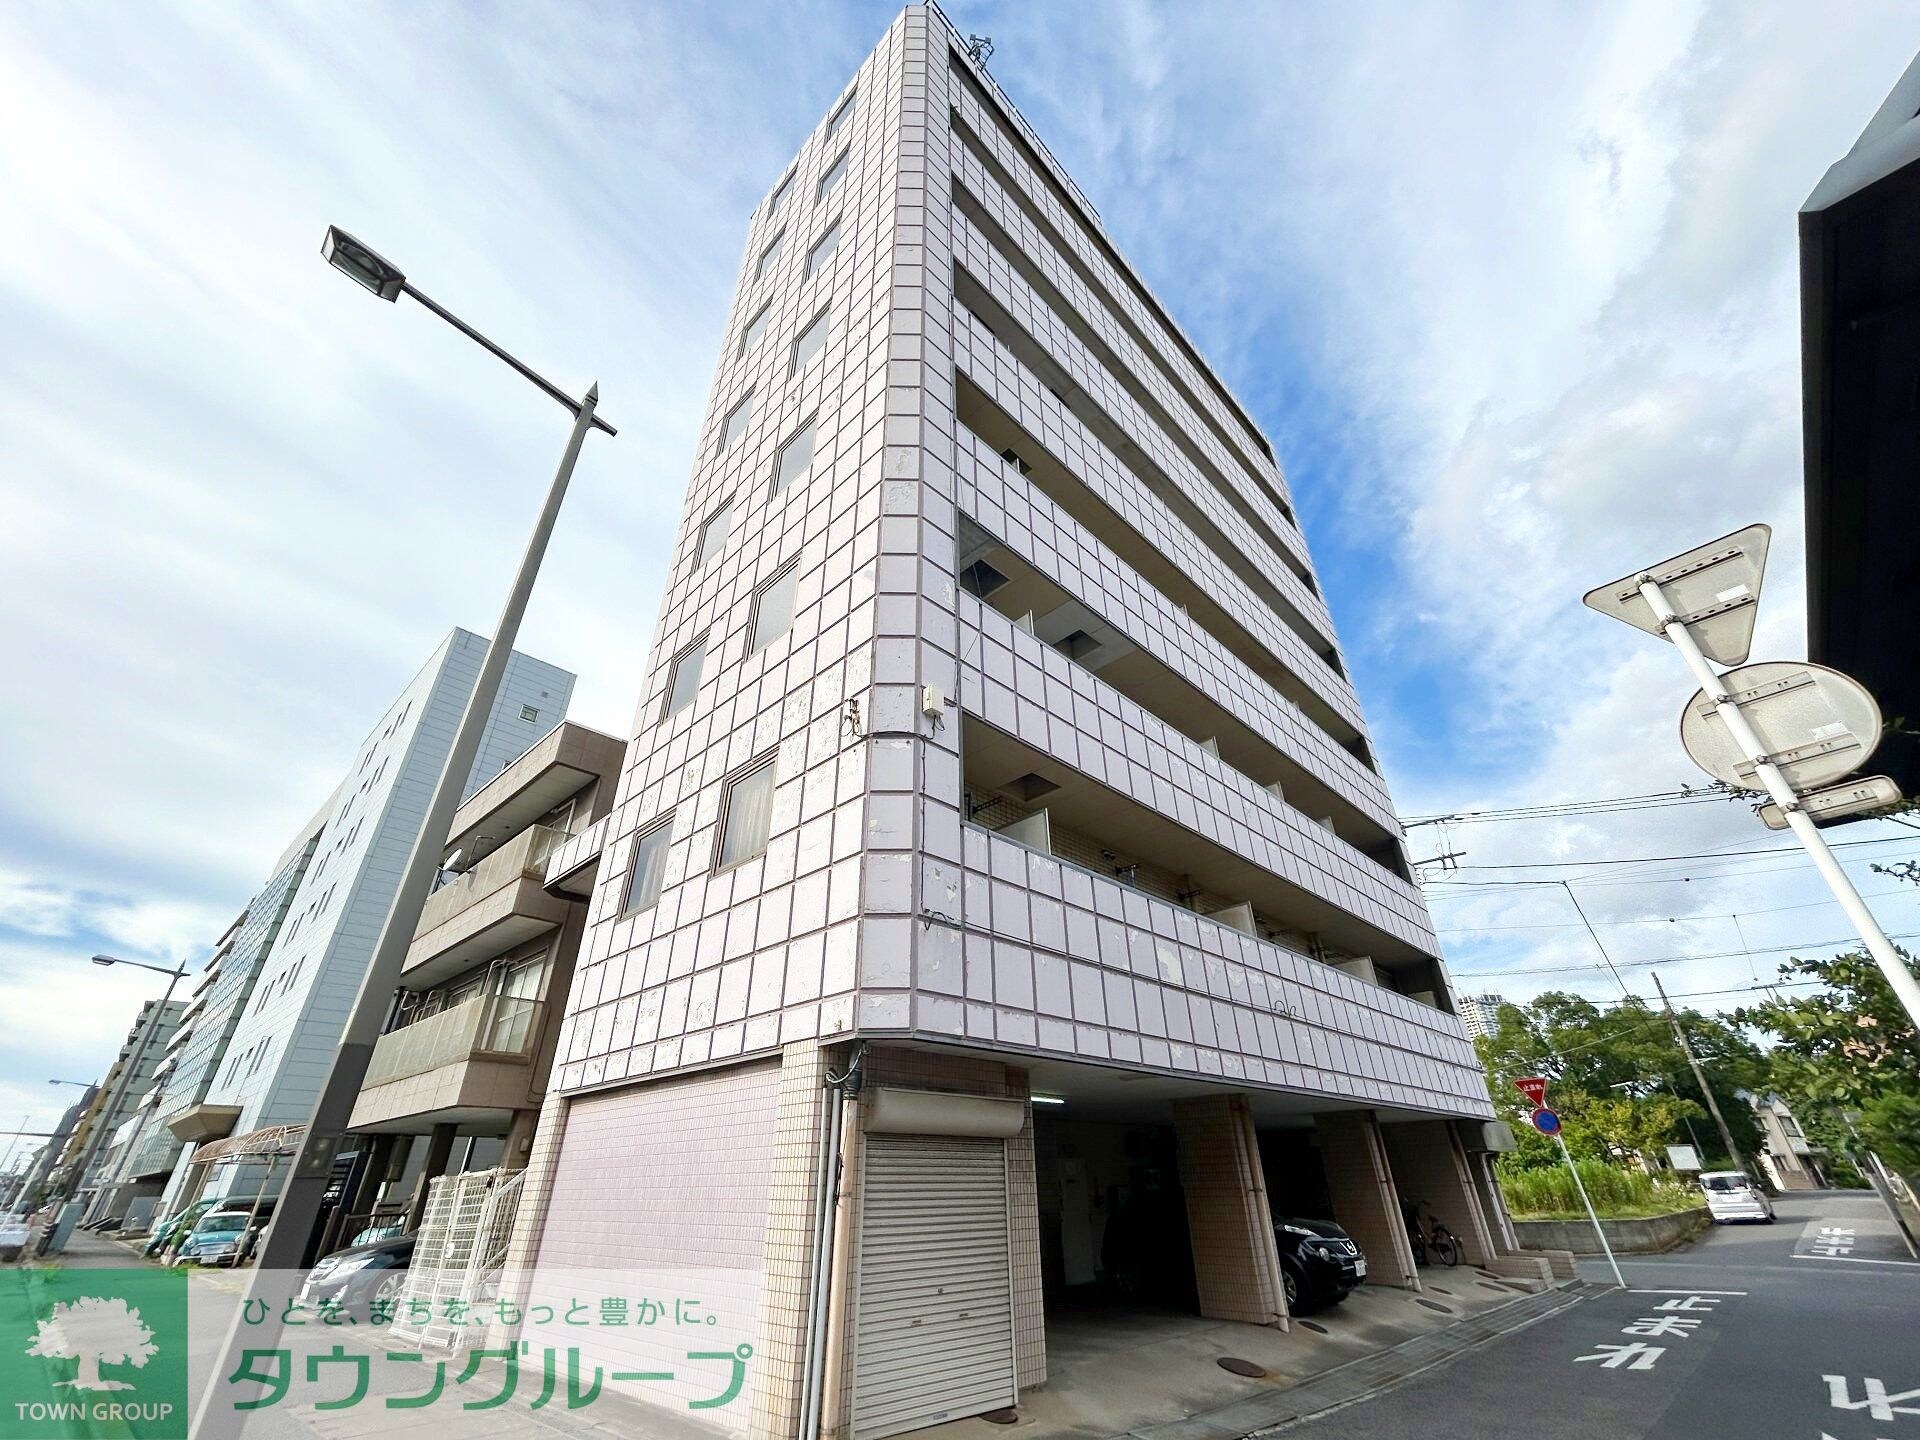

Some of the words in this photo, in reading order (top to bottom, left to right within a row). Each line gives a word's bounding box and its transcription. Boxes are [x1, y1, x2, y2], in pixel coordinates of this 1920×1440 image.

[1523, 1083, 1544, 1092] 止まれ
[1572, 1296, 1721, 1370] 止まれ
